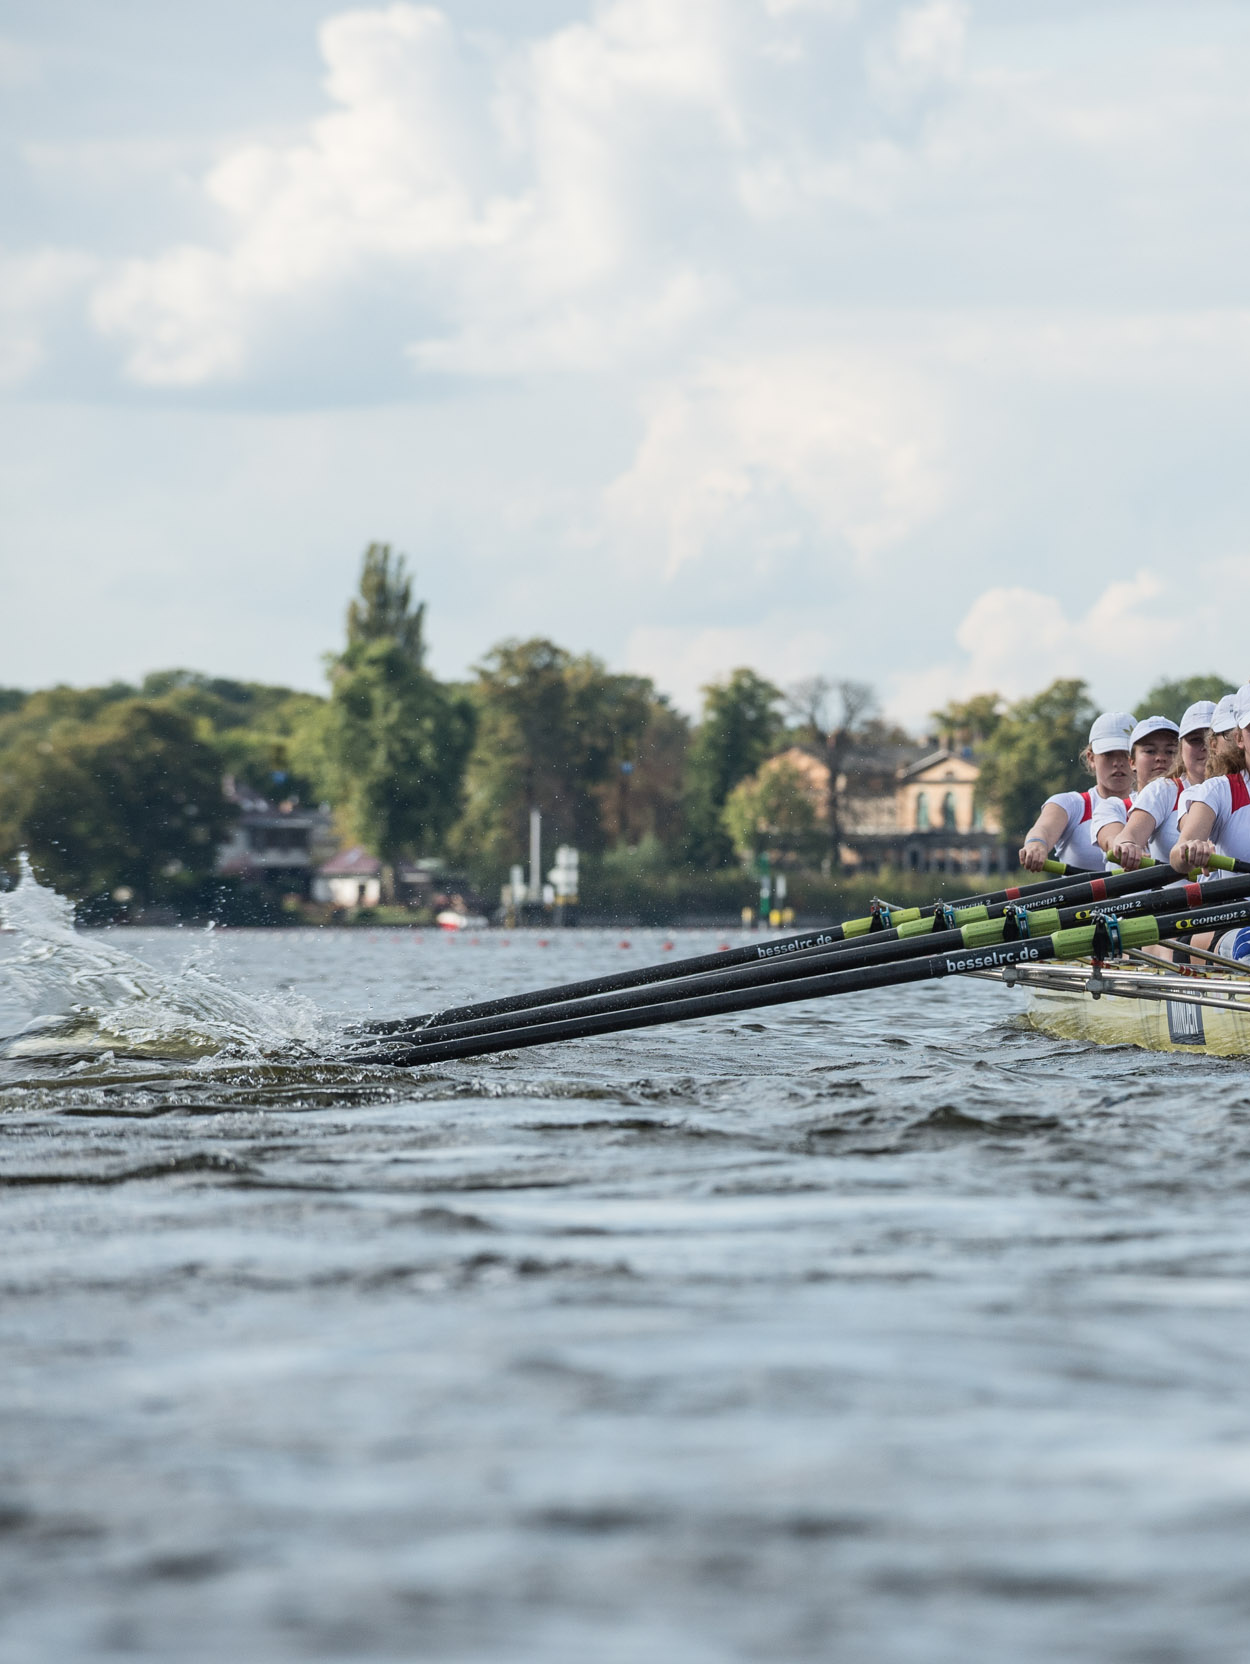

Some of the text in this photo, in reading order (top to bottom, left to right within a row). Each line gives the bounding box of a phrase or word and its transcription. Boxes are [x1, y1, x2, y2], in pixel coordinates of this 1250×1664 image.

[1135, 900, 1142, 908] 2
[1192, 911, 1239, 926] concept
[1240, 910, 1247, 918] 2
[757, 934, 832, 958] besselrc.de
[946, 946, 1039, 973] besselrc.de
